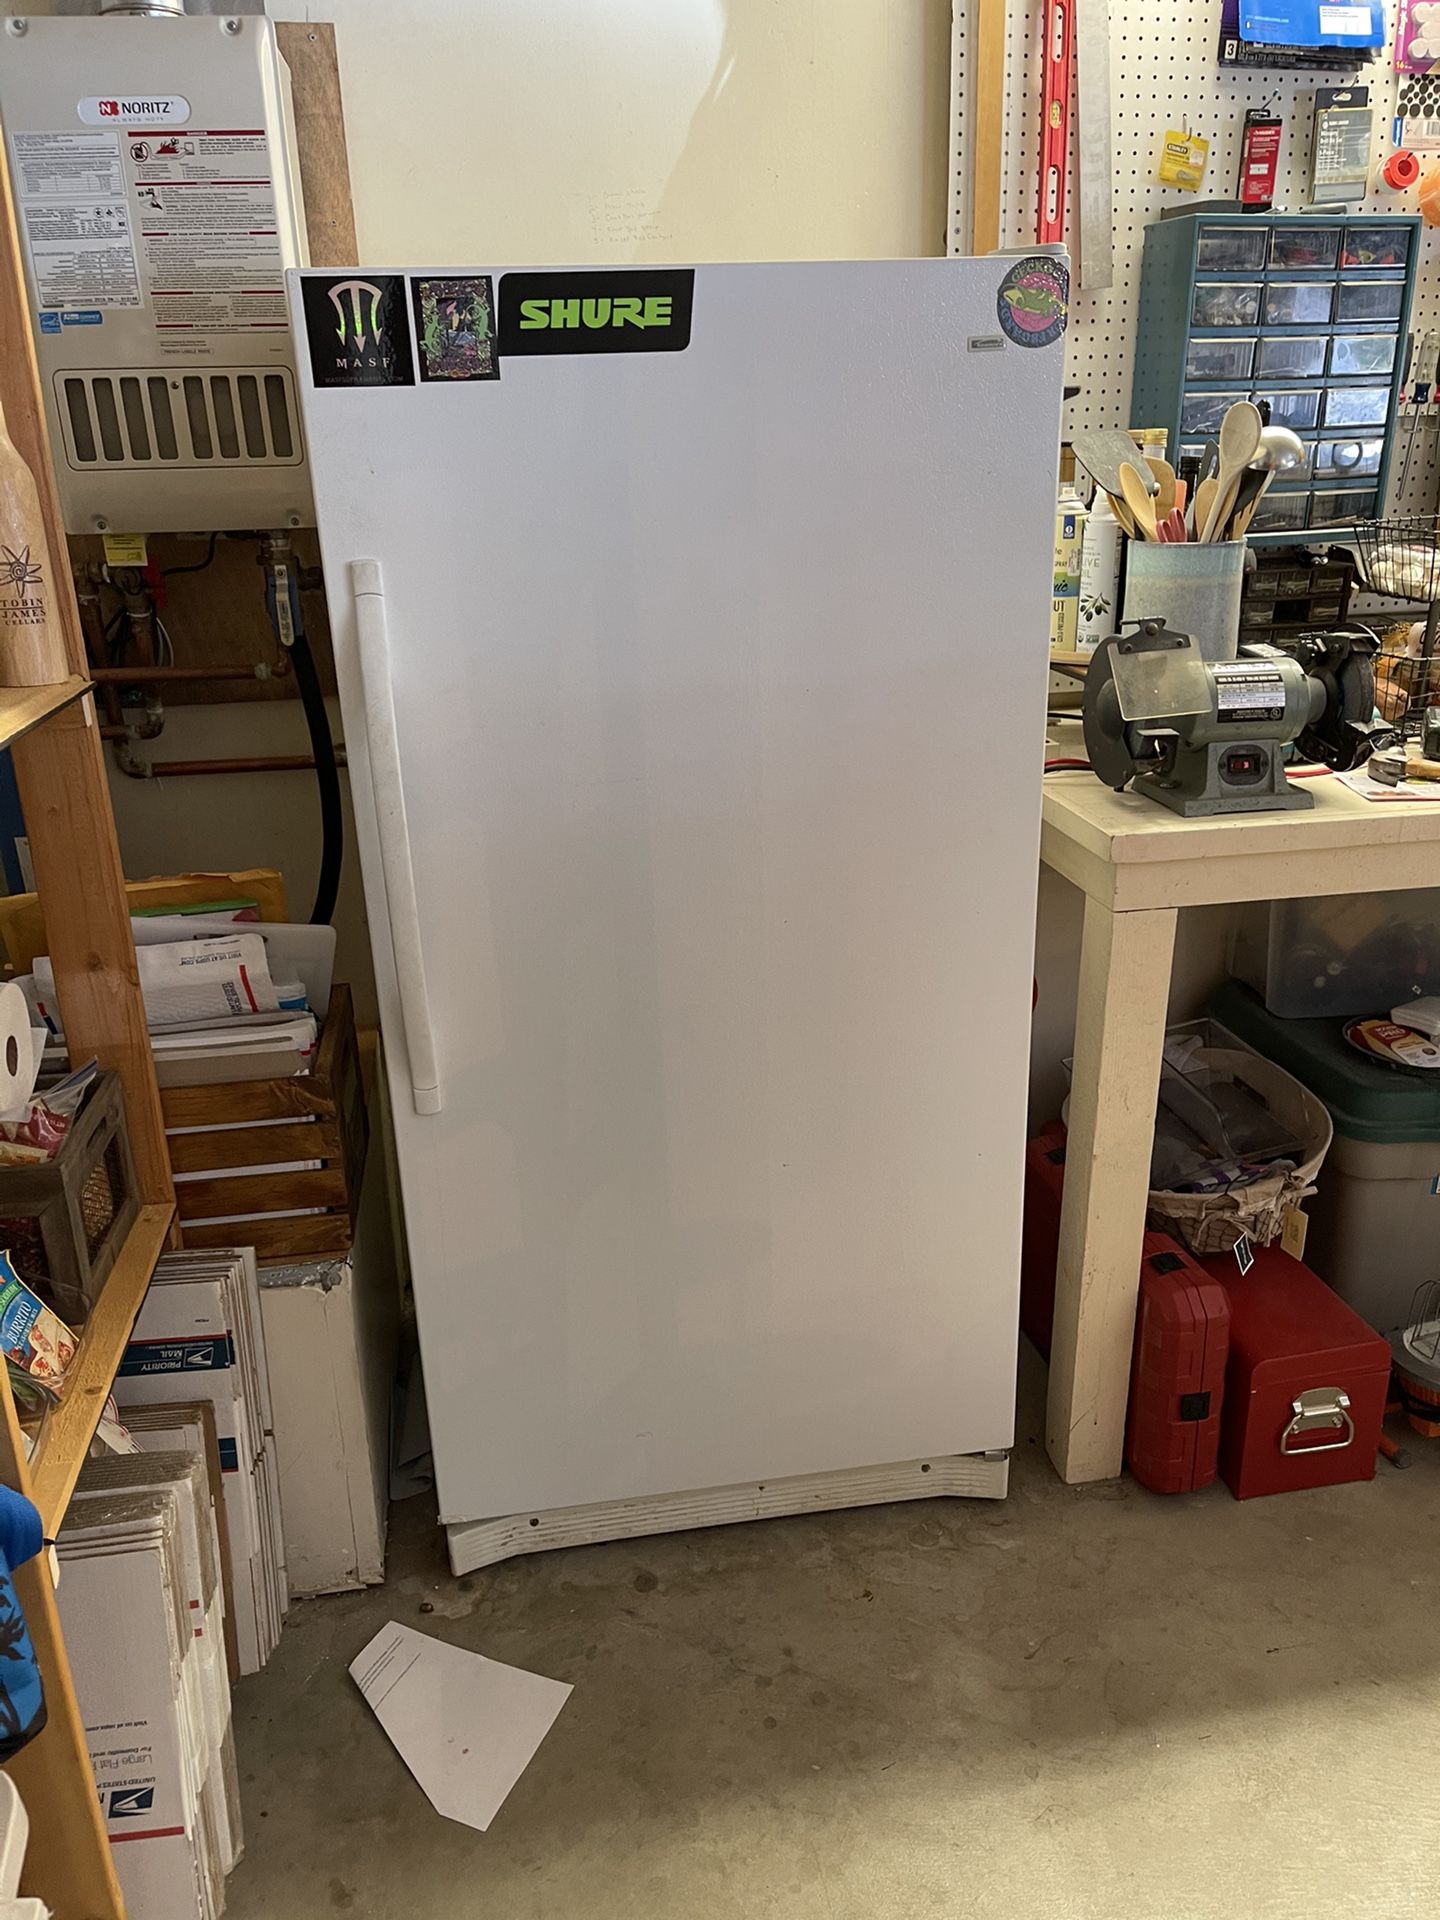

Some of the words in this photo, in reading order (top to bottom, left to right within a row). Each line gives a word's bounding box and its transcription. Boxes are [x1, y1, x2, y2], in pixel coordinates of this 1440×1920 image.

[1227, 43, 1234, 56] 3
[122, 101, 170, 114] NORITZ
[519, 296, 673, 330] SHURE
[335, 357, 391, 369] MASF
[0, 597, 43, 607] TOBIN
[2, 609, 46, 619] JAMES
[5, 618, 45, 626] CELLARS
[6, 1301, 32, 1345] BURRITO
[160, 1350, 183, 1358] MAIL
[141, 1361, 181, 1371] PRIORITY
[100, 1759, 119, 1770] Flat
[122, 1754, 152, 1766] Large
[103, 1779, 127, 1788] STATES
[128, 1776, 156, 1785] UNITED
